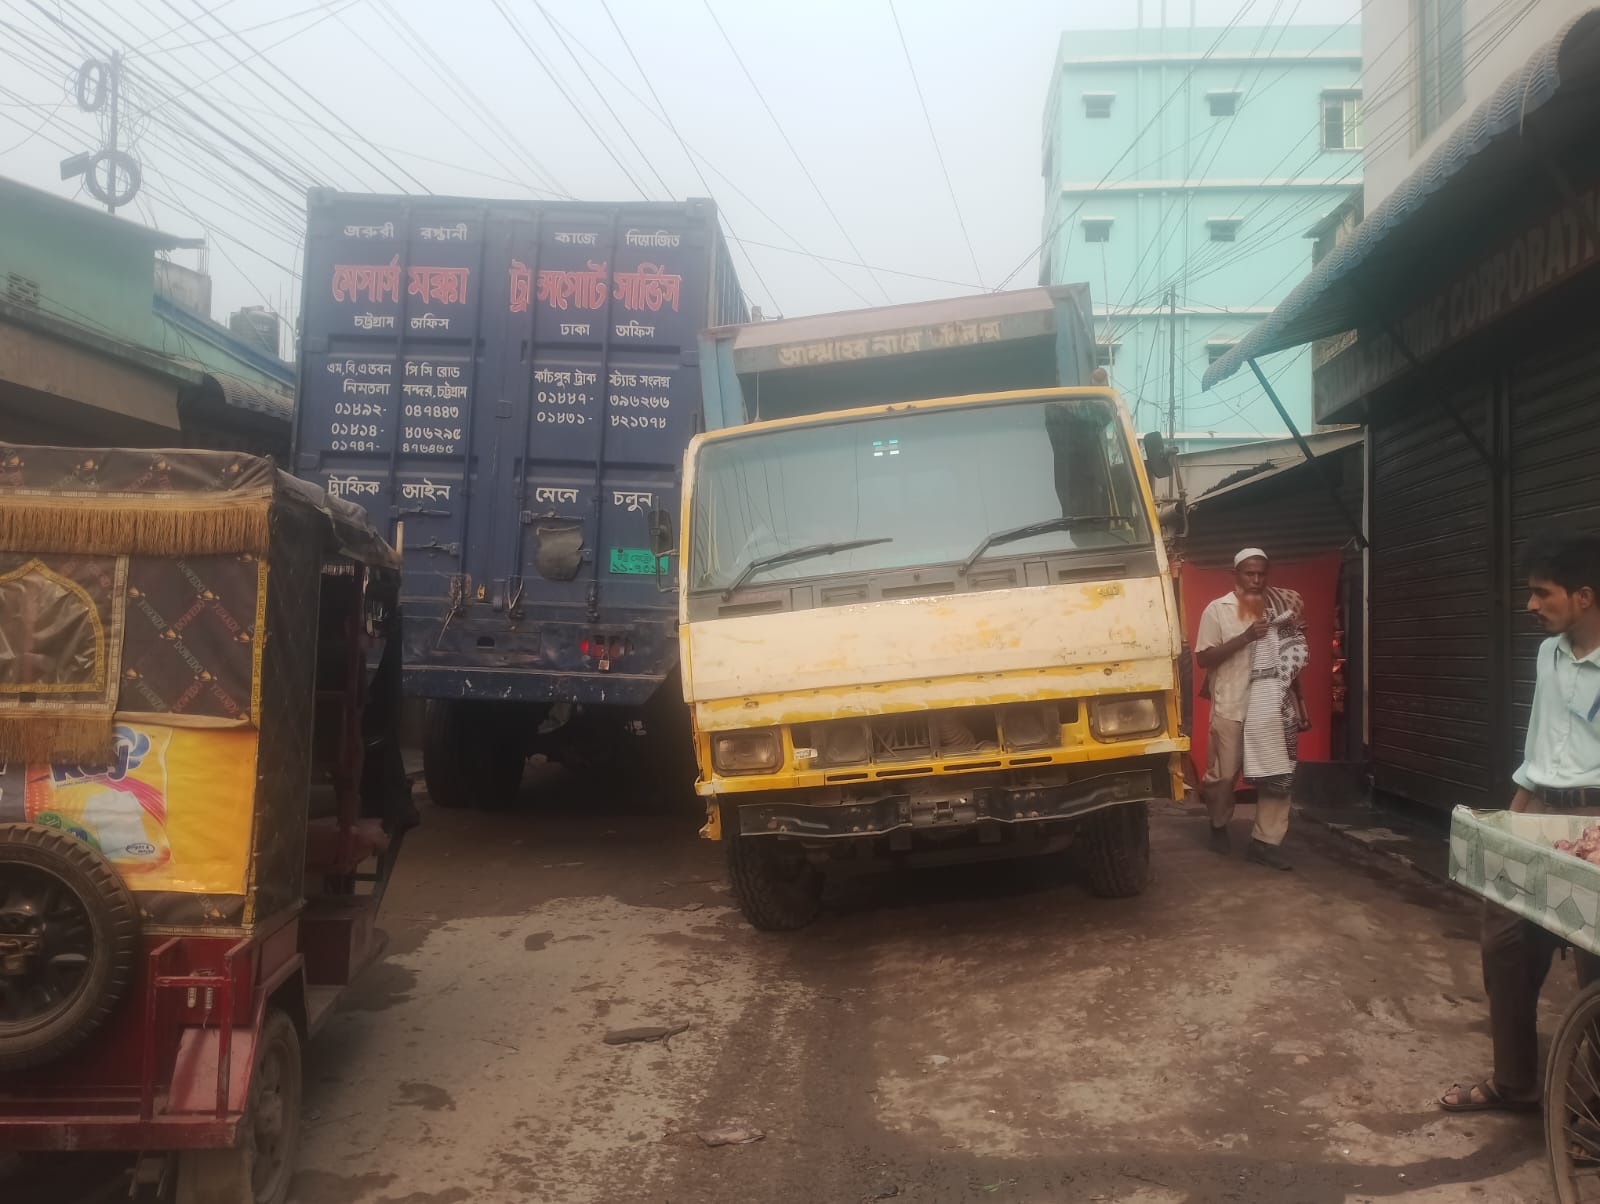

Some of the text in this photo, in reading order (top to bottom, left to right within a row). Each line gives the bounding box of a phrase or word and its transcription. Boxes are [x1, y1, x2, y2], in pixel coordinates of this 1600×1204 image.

[343, 222, 394, 239] জরুরী
[554, 231, 598, 246] কাজে
[625, 228, 680, 248] নিয়োজিত
[332, 253, 401, 303] মেসার্স
[408, 266, 469, 305] মক্কা
[613, 262, 682, 313] সার্ভিস
[353, 312, 449, 330] চট্টগ্রাম অফিস
[560, 320, 655, 338] ঢাকা অফিস
[436, 366, 460, 378] রোড
[574, 367, 597, 387] ট্রাক
[343, 378, 391, 395] নিমতলা
[328, 475, 452, 502] ট্রাফিক আইন
[535, 487, 653, 512] মেনে চলুন
